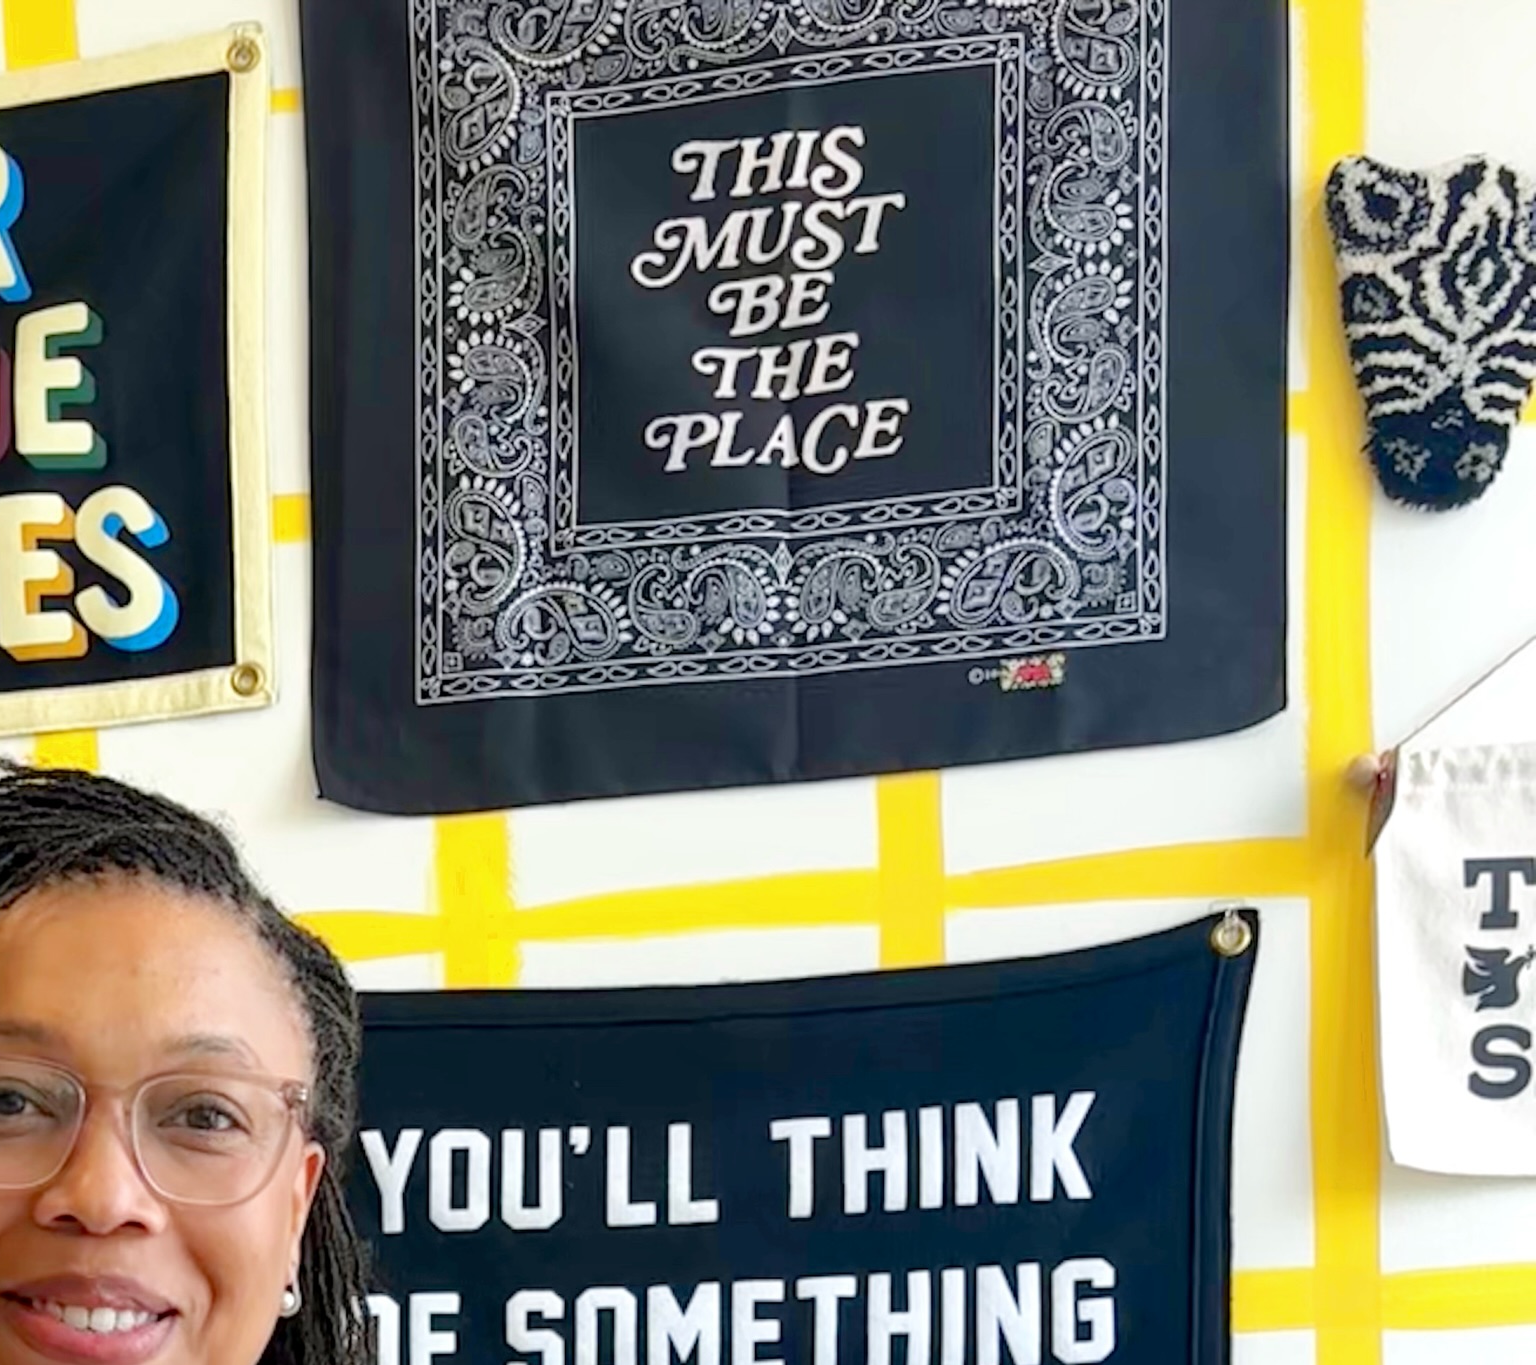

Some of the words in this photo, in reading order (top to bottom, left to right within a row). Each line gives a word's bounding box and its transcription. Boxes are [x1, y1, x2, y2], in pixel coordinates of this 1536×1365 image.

[671, 125, 865, 201] THIS
[630, 193, 906, 288] MUST
[707, 271, 834, 337] BE
[692, 332, 859, 400] THE
[644, 398, 910, 474] PLACE
[361, 1122, 719, 1236] YOU'LL
[769, 1091, 1096, 1219] THINK
